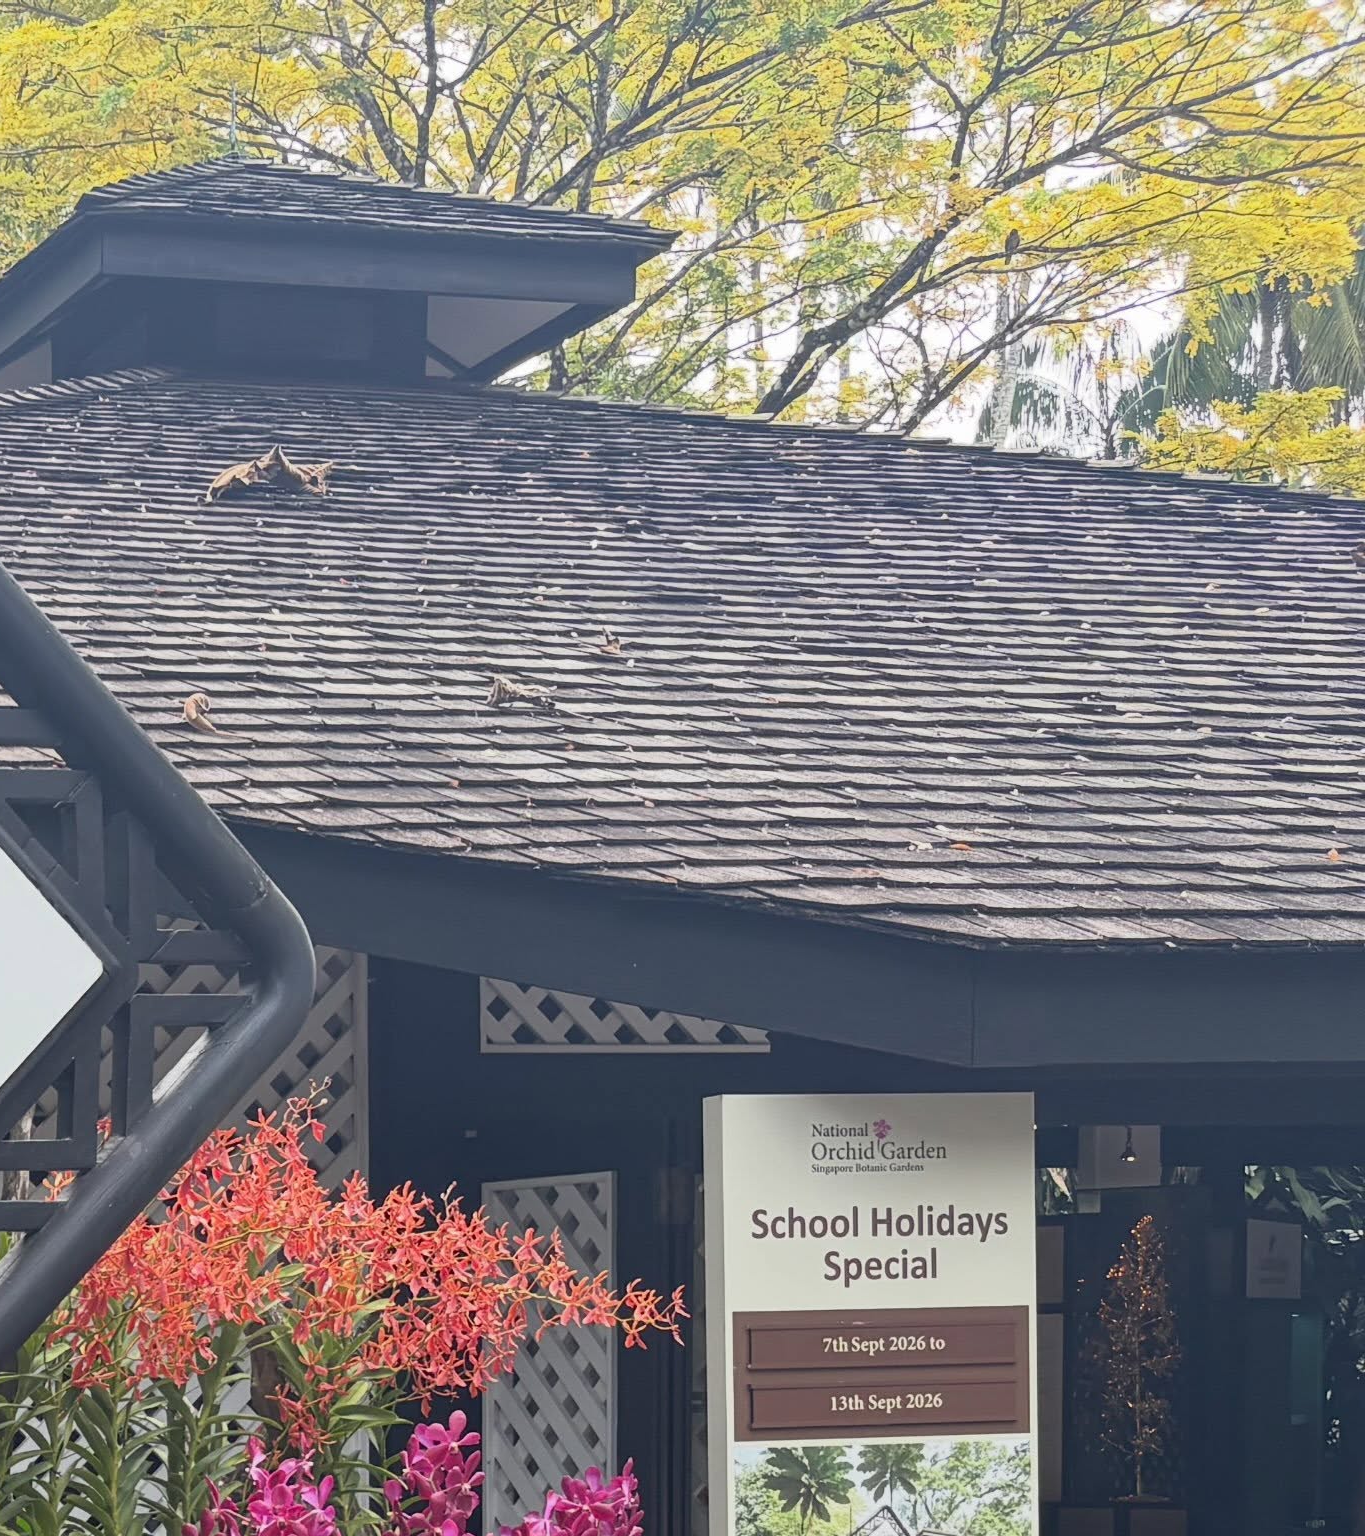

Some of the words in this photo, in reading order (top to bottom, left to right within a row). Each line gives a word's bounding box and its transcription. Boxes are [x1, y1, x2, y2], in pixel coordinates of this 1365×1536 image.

[811, 1122, 868, 1137] National
[811, 1141, 875, 1160] Orchid
[881, 1140, 947, 1160] Garden
[811, 1163, 853, 1175] Singapore
[856, 1163, 887, 1173] Botanic
[889, 1162, 924, 1172] Gardens
[751, 1206, 858, 1239] School
[871, 1204, 1008, 1242] Holidays
[824, 1247, 937, 1288] Special
[822, 1337, 848, 1352] 7th
[851, 1336, 885, 1356] Sept
[889, 1336, 926, 1351] 2026
[929, 1337, 946, 1350] to
[831, 1394, 864, 1411] 13th
[868, 1395, 902, 1413] Sept
[905, 1393, 943, 1408] 2026
